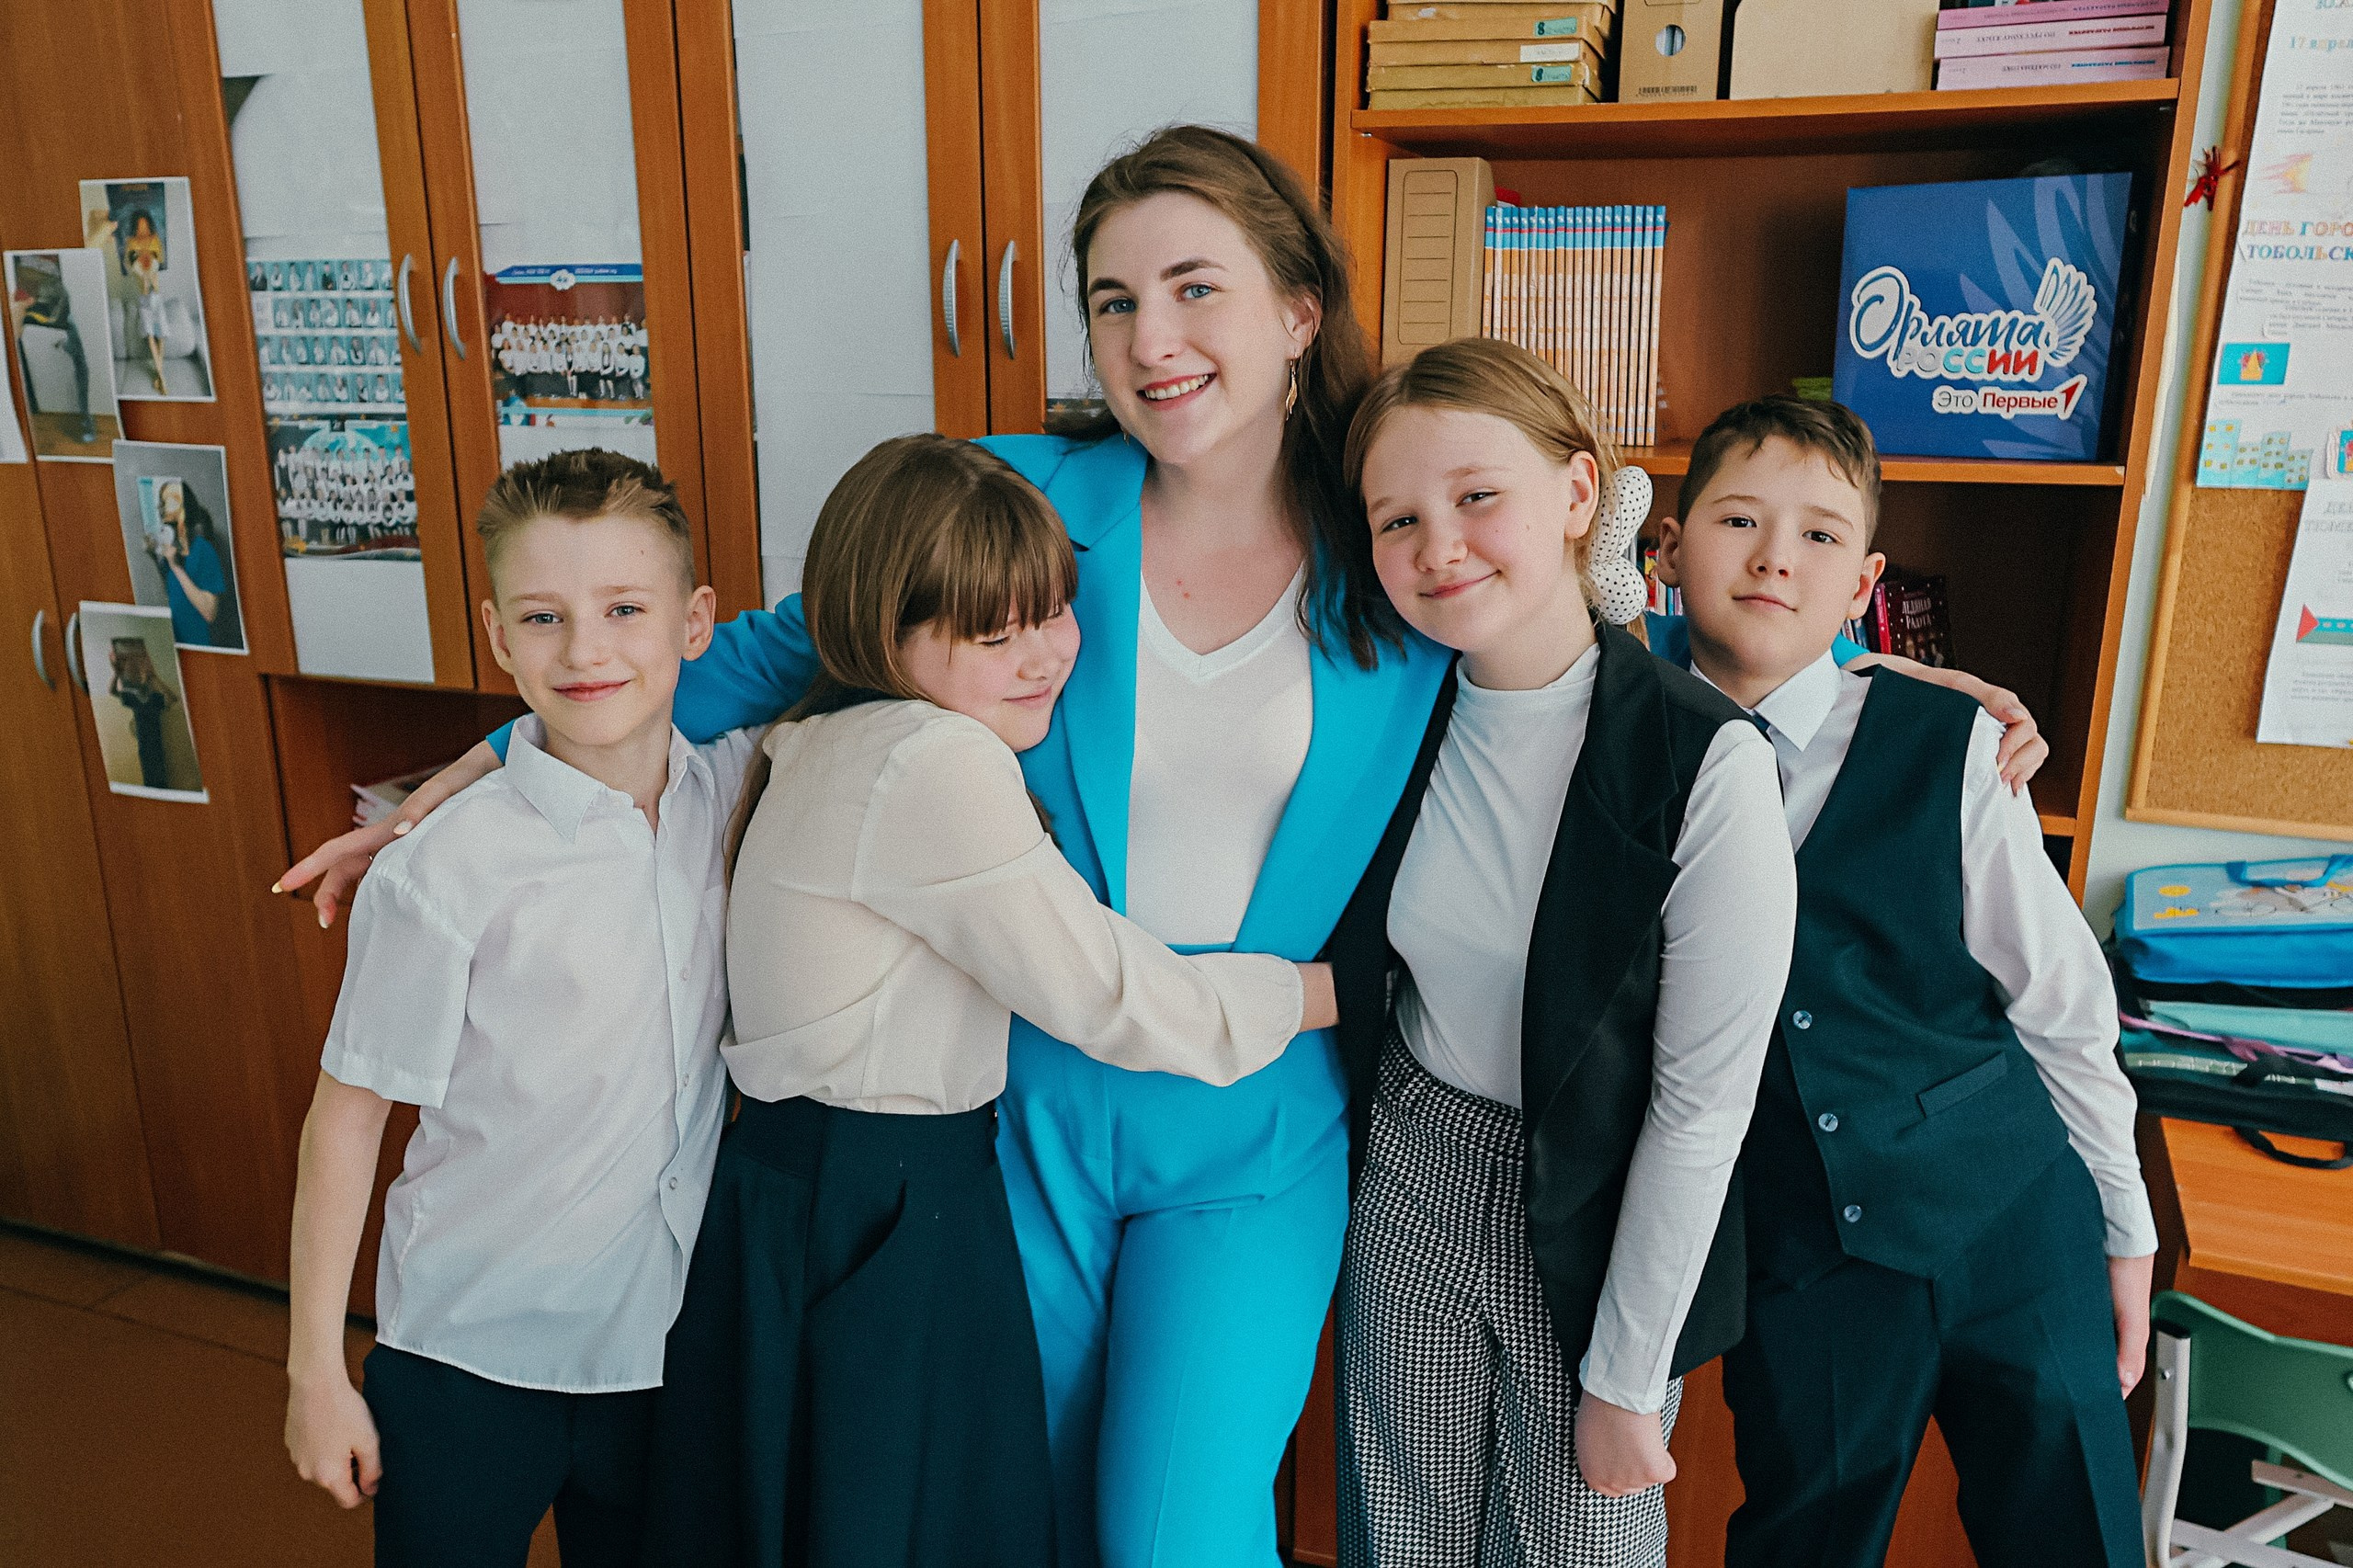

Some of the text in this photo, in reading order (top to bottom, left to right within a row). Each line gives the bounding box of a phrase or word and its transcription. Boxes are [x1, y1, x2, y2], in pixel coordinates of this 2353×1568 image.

[2242, 220, 2295, 237] ДЕНЬ
[1855, 272, 2051, 361] Орлята
[1936, 390, 2059, 415] Это Первые
